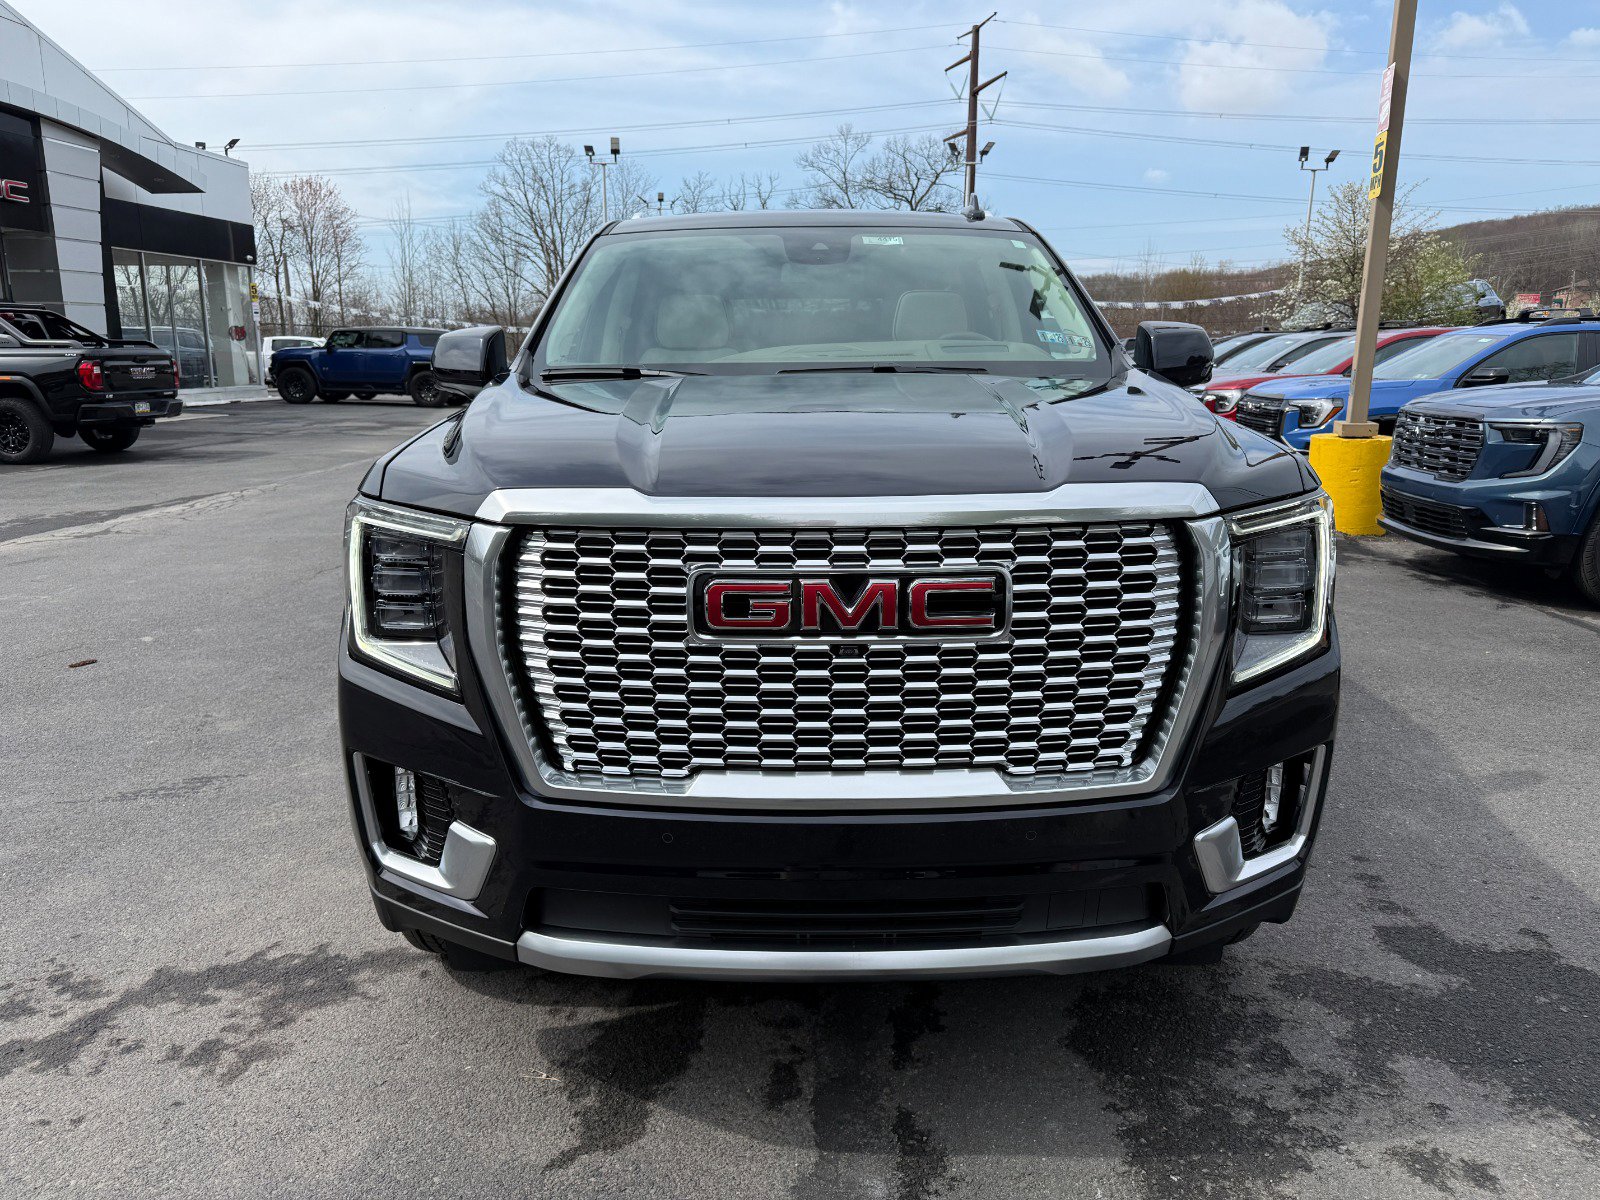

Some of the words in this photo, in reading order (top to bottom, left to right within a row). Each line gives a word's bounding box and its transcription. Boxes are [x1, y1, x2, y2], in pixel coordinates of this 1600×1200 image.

[1373, 141, 1384, 173] 5
[251, 285, 257, 295] 5
[704, 577, 997, 630] GMC
